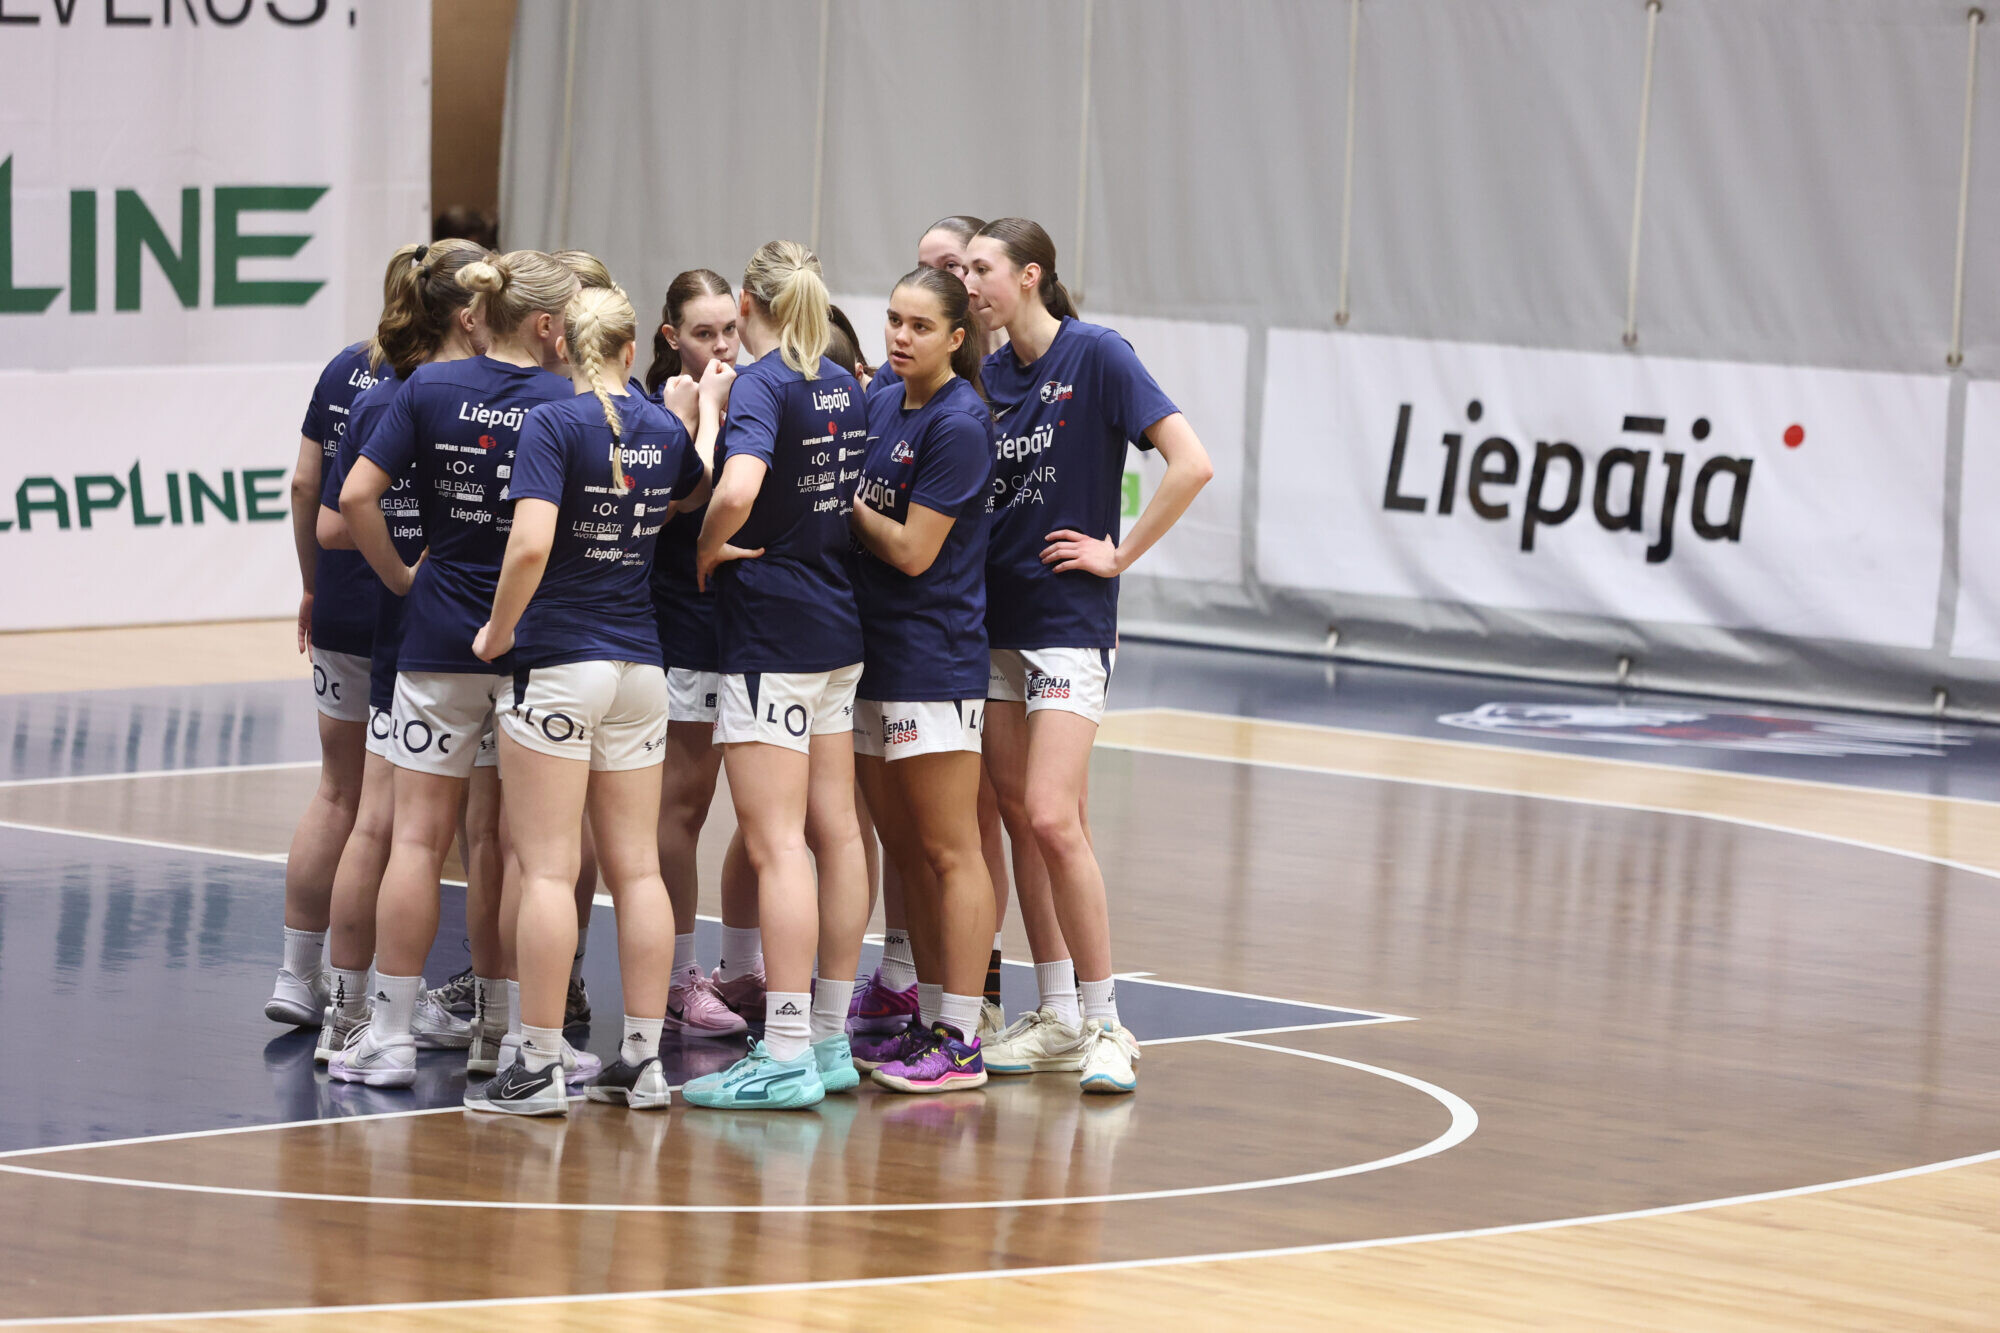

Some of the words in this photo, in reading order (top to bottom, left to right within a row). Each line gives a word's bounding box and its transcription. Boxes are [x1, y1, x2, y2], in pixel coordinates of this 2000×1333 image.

[812, 387, 850, 414] Liepāja
[1382, 399, 1754, 565] Liepāja
[0, 459, 290, 532] APLINE
[450, 507, 492, 524] Liepāja
[572, 520, 622, 534] LIELBĀTA
[584, 547, 623, 563] Liepāja
[1040, 688, 1071, 699] LSSS
[892, 729, 919, 745] LSSS
